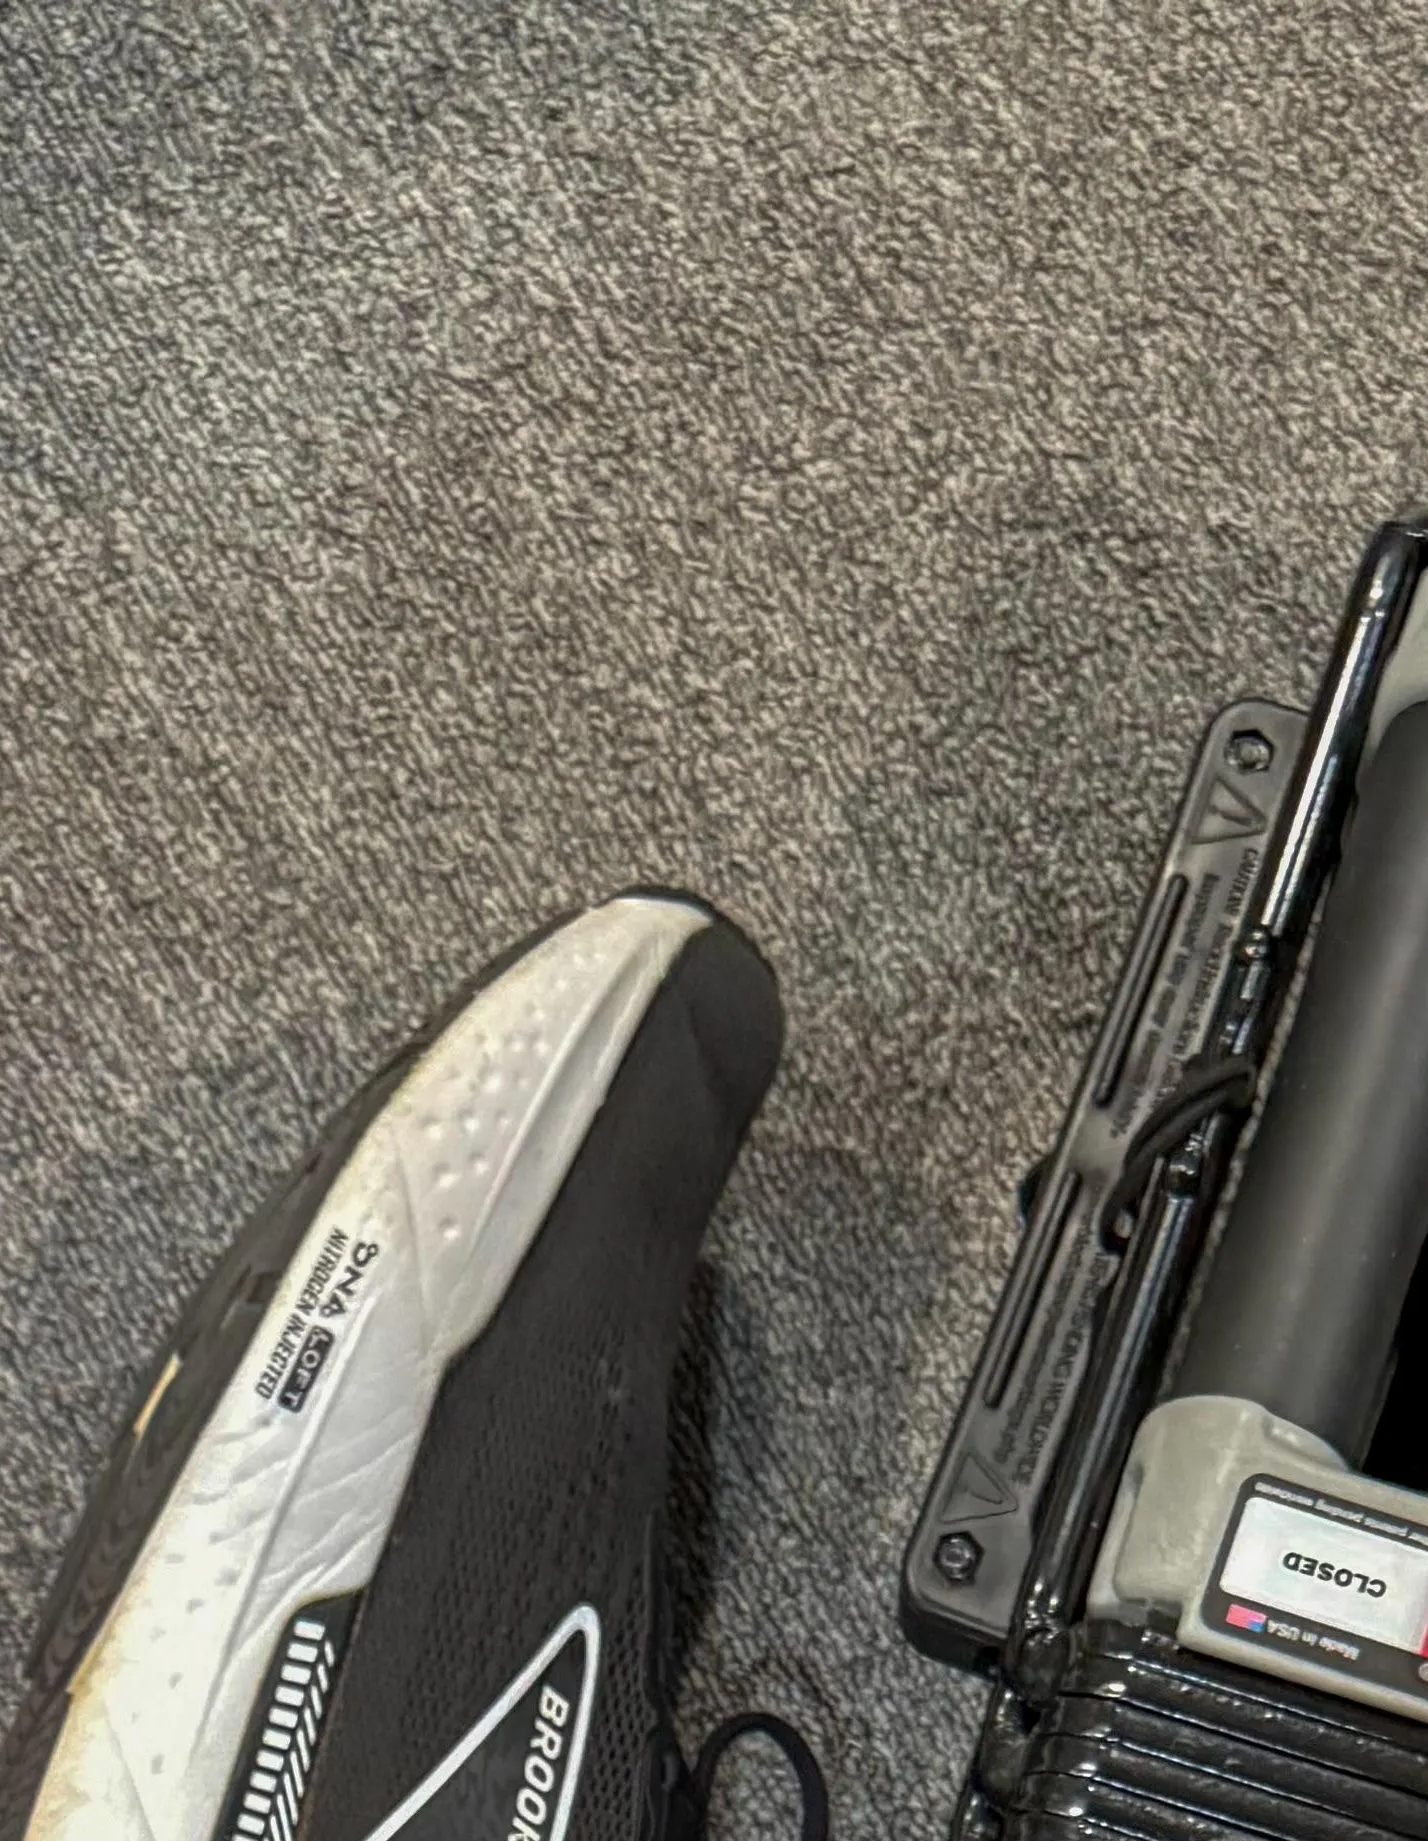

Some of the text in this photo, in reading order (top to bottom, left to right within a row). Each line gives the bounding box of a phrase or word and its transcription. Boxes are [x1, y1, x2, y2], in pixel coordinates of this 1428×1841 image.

[252, 1226, 350, 1400] NITROGEN INJECTED
[281, 1238, 380, 1407] DNA LOFT
[1280, 1550, 1387, 1599] CLOSED
[1265, 1618, 1360, 1661] Made in USA
